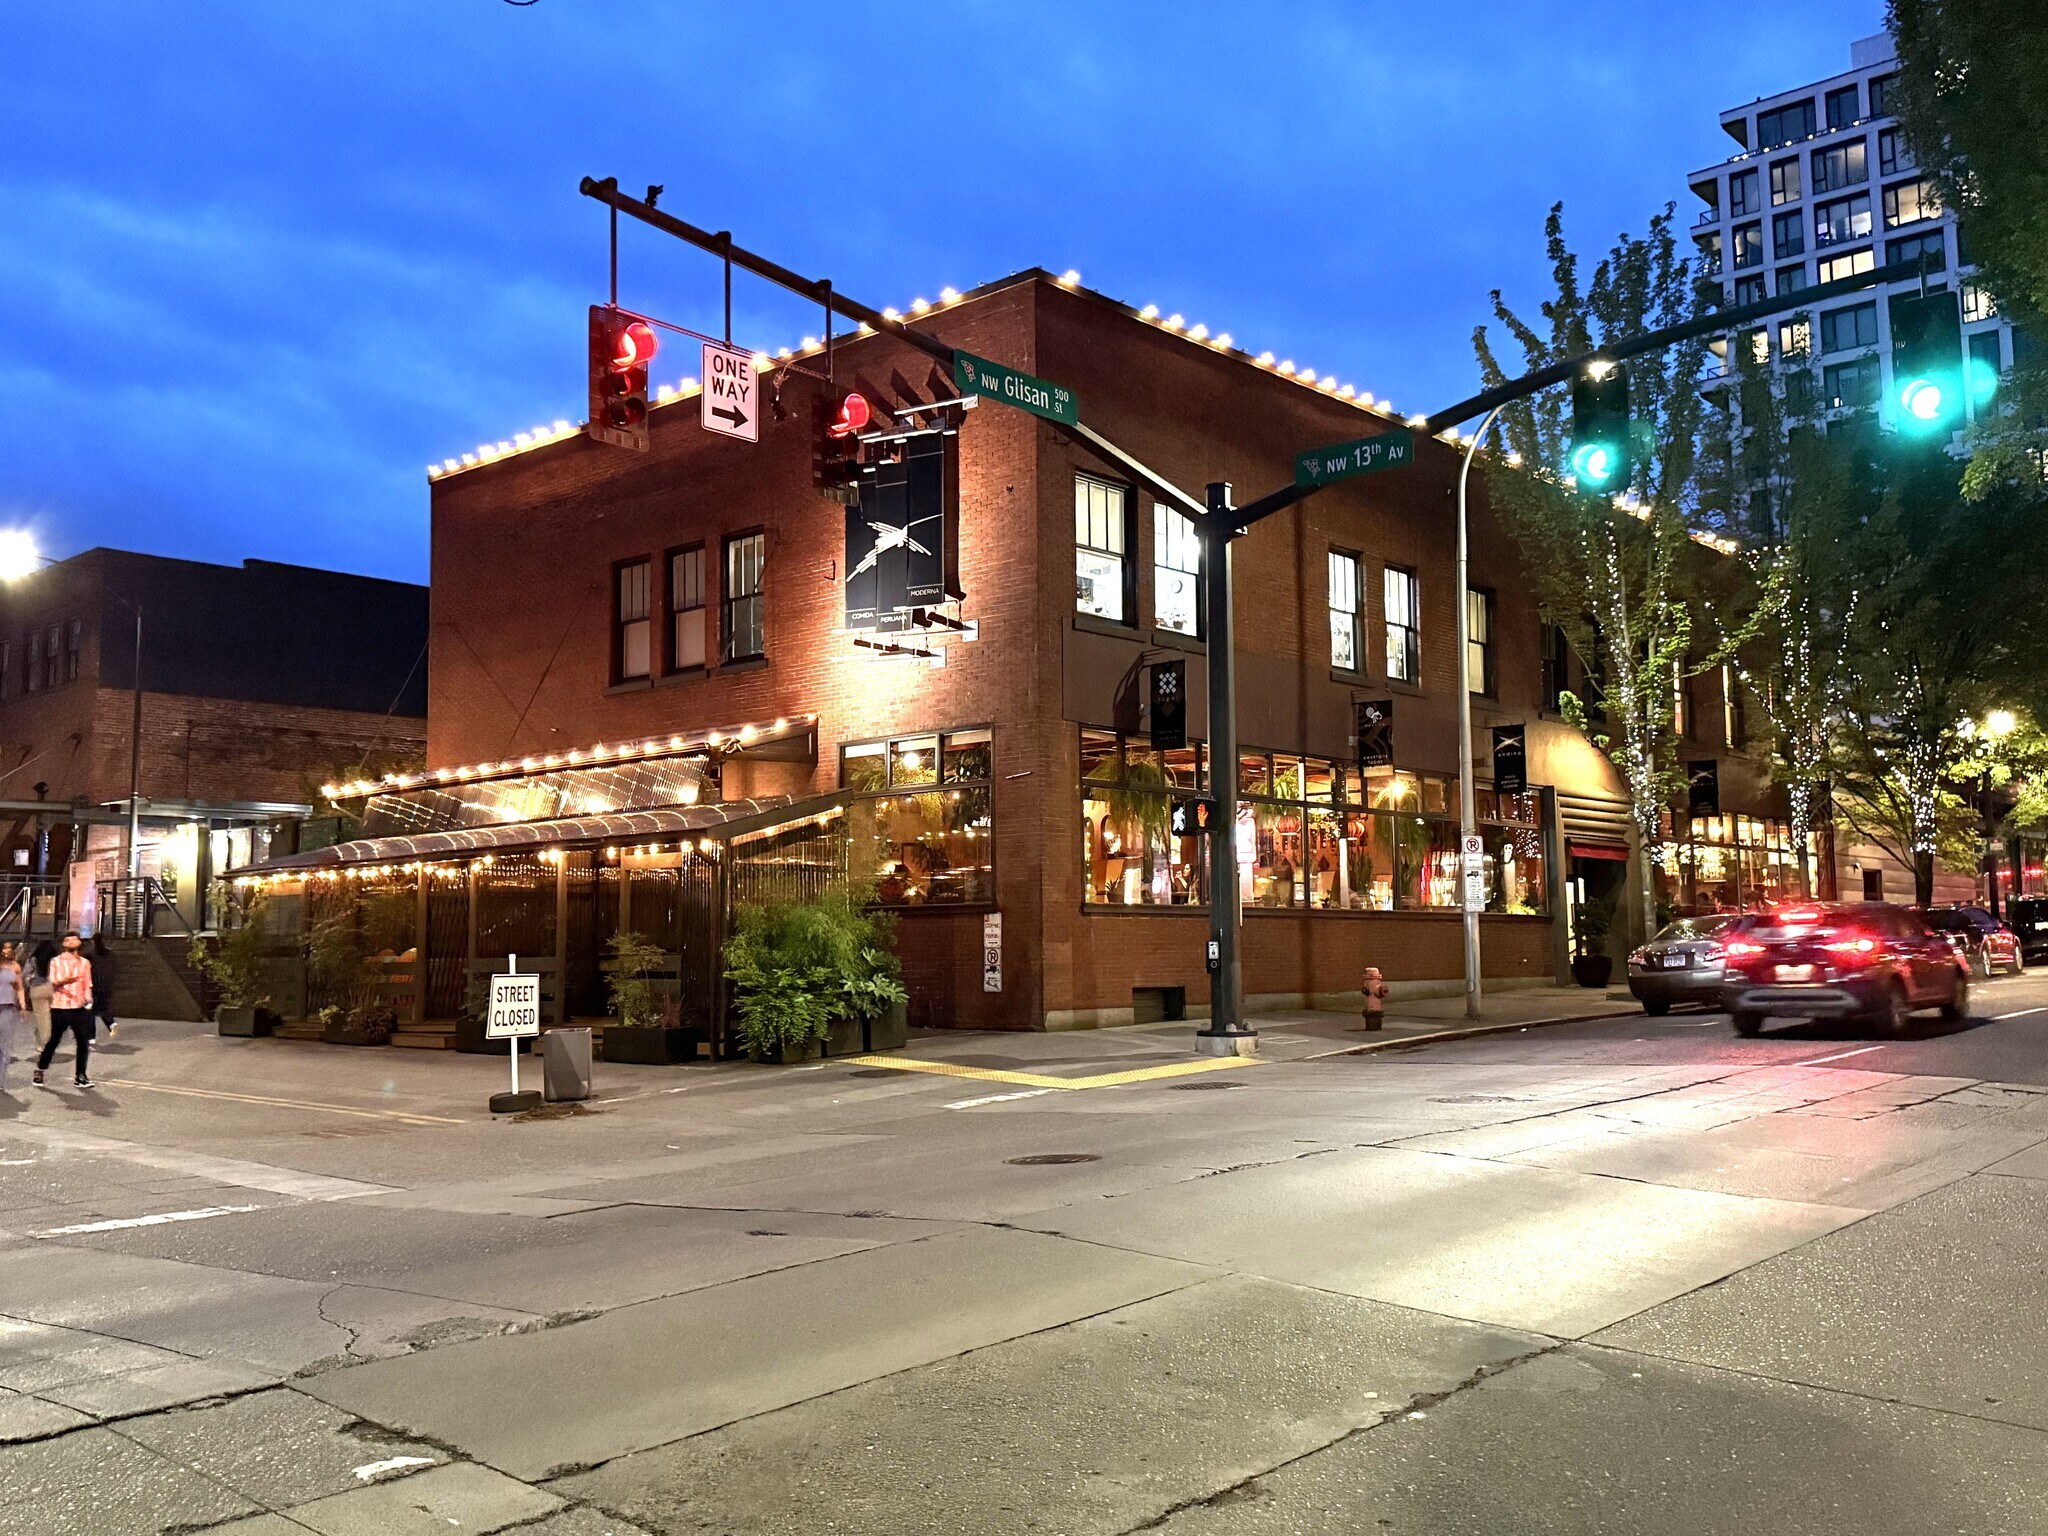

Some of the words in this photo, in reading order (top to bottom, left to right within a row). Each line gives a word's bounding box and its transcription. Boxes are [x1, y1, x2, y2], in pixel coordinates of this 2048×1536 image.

[713, 354, 749, 382] ONE
[711, 375, 750, 403] WAY
[981, 373, 999, 392] NW
[1004, 375, 1049, 409] Glisan
[1054, 388, 1069, 403] 500
[1055, 402, 1063, 414] St
[1327, 456, 1347, 474] NW
[1353, 443, 1382, 467] 13th
[1388, 446, 1404, 461] Av
[910, 588, 940, 597] MODERNA
[851, 611, 874, 620] COMIDA
[496, 985, 535, 1003] STREET
[494, 1008, 535, 1027] CLOSED
